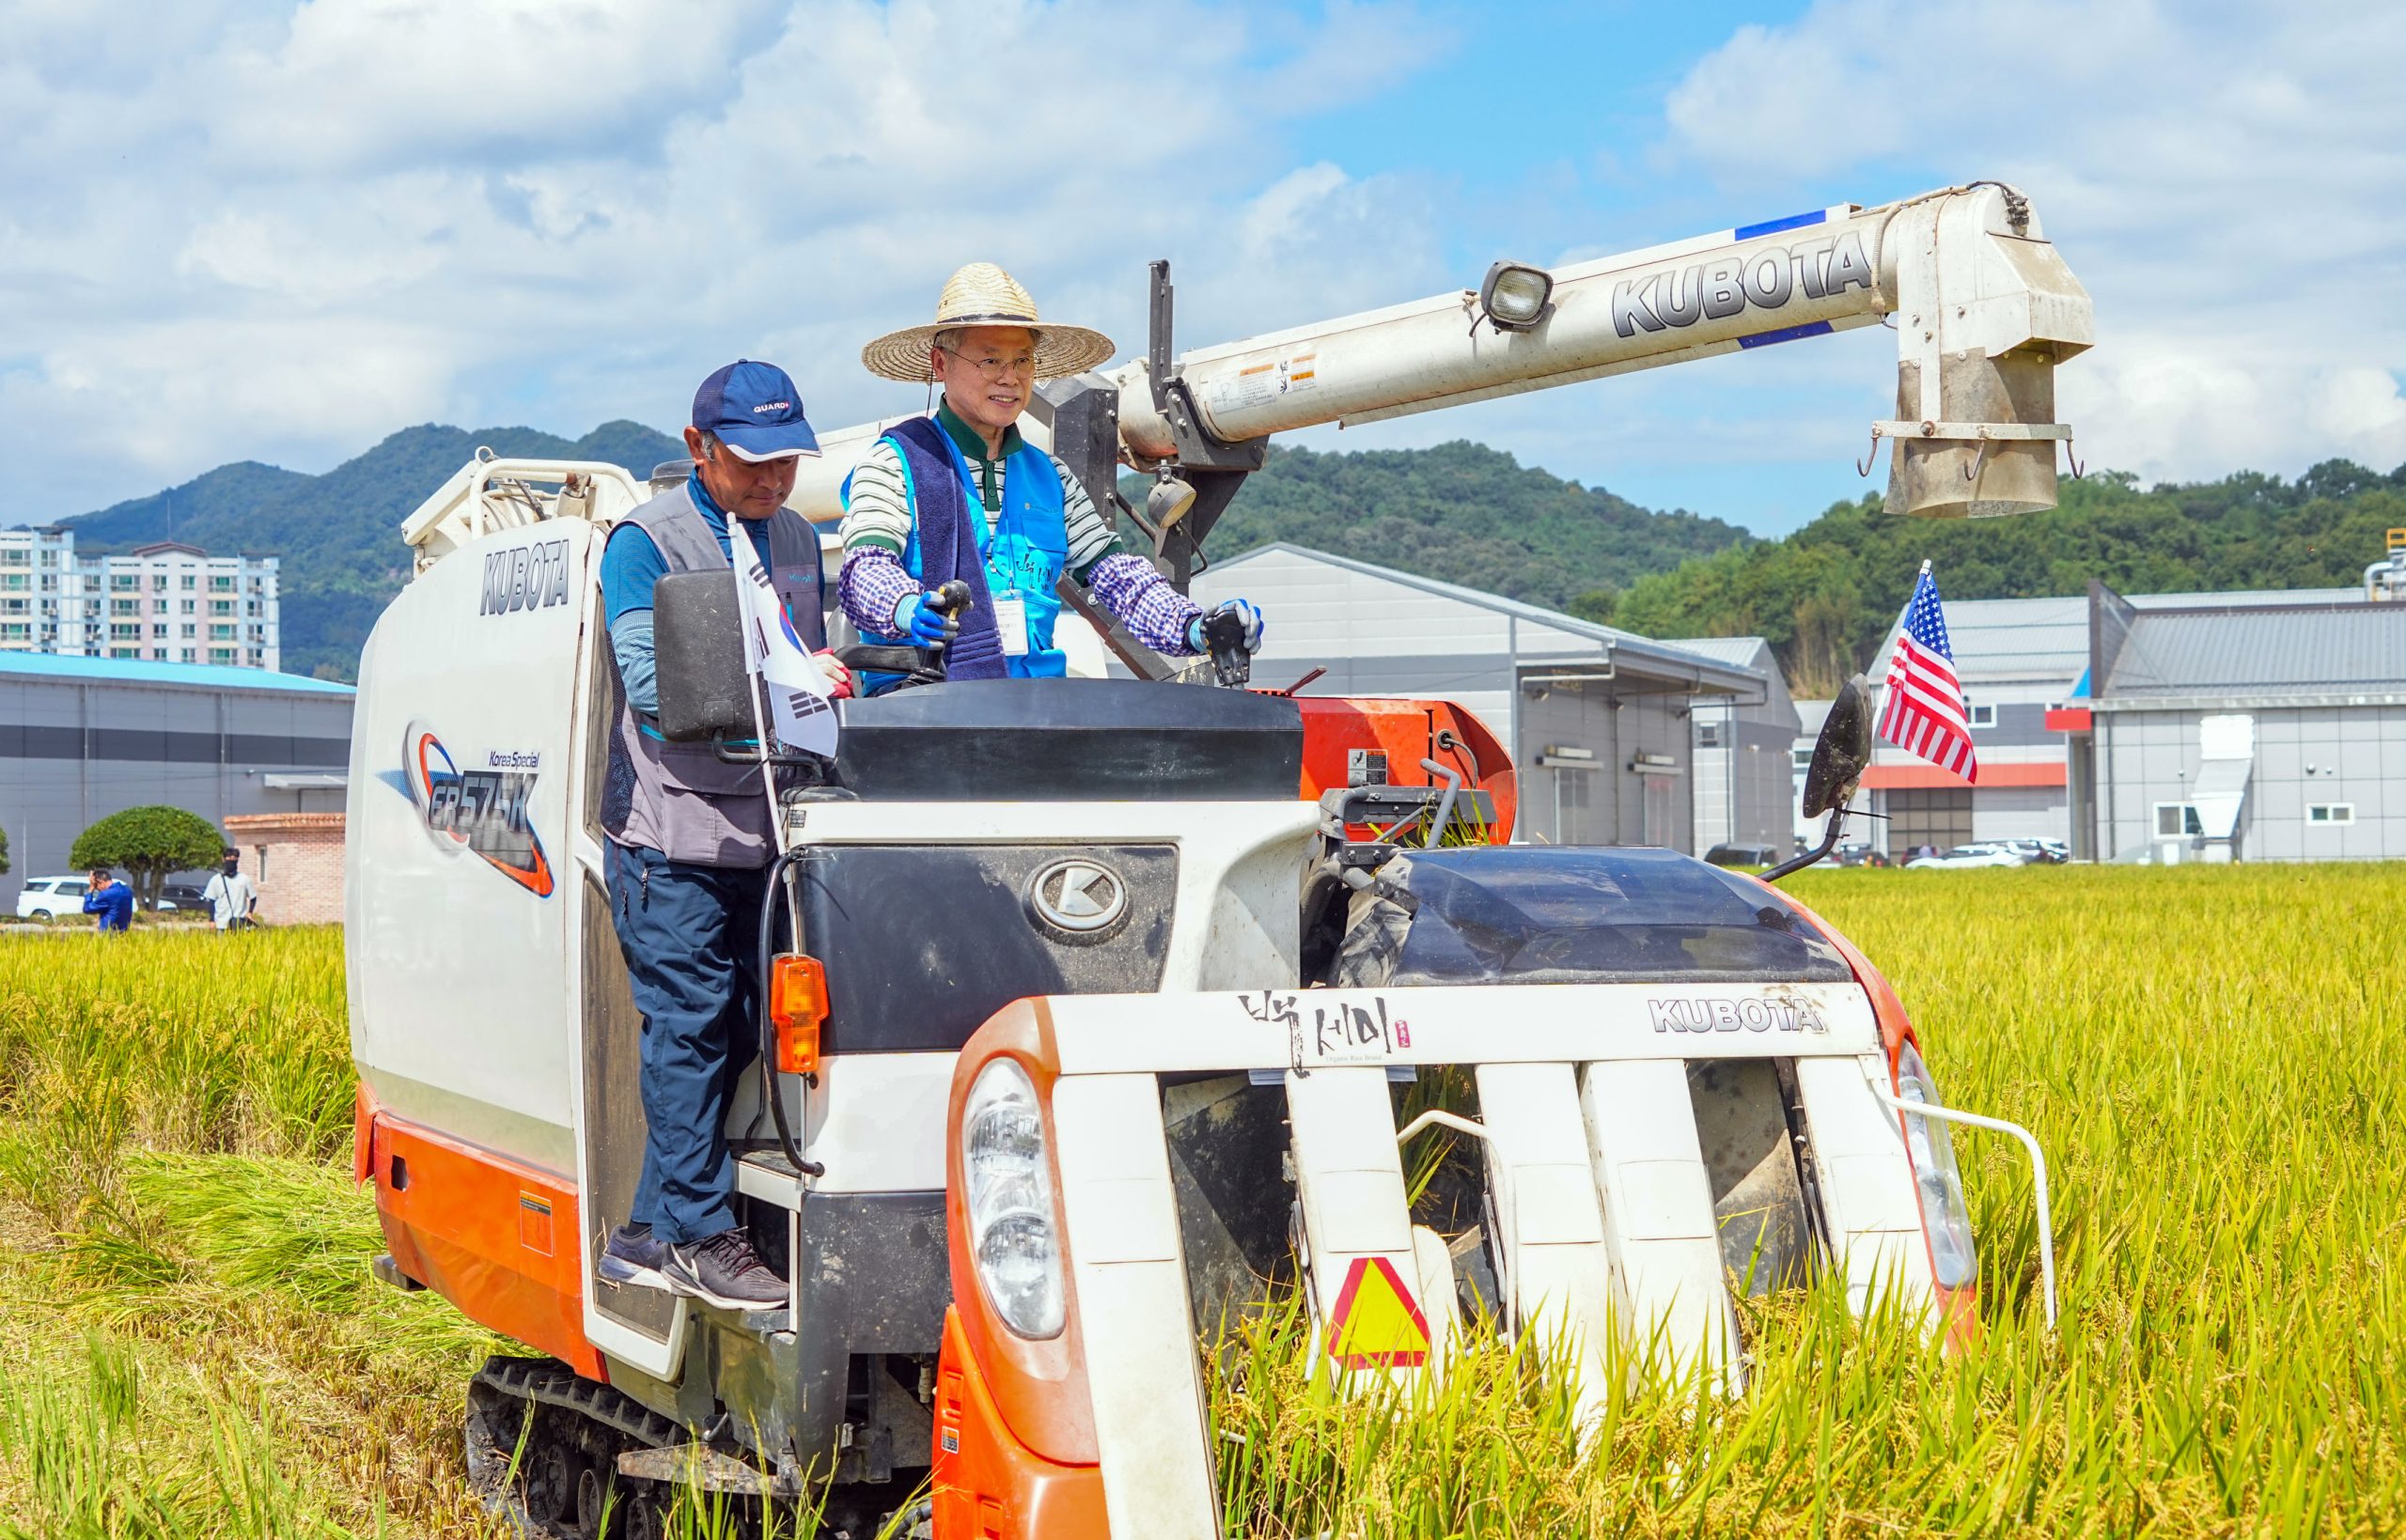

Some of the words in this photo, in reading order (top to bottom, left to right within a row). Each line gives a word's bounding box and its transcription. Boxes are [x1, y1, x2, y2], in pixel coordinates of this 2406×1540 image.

[1612, 231, 1872, 338] KUBOTA
[480, 539, 569, 616] KUBOTA
[489, 751, 510, 767] Korea
[510, 752, 539, 770] Special
[1648, 998, 1823, 1034] KUBOTA
